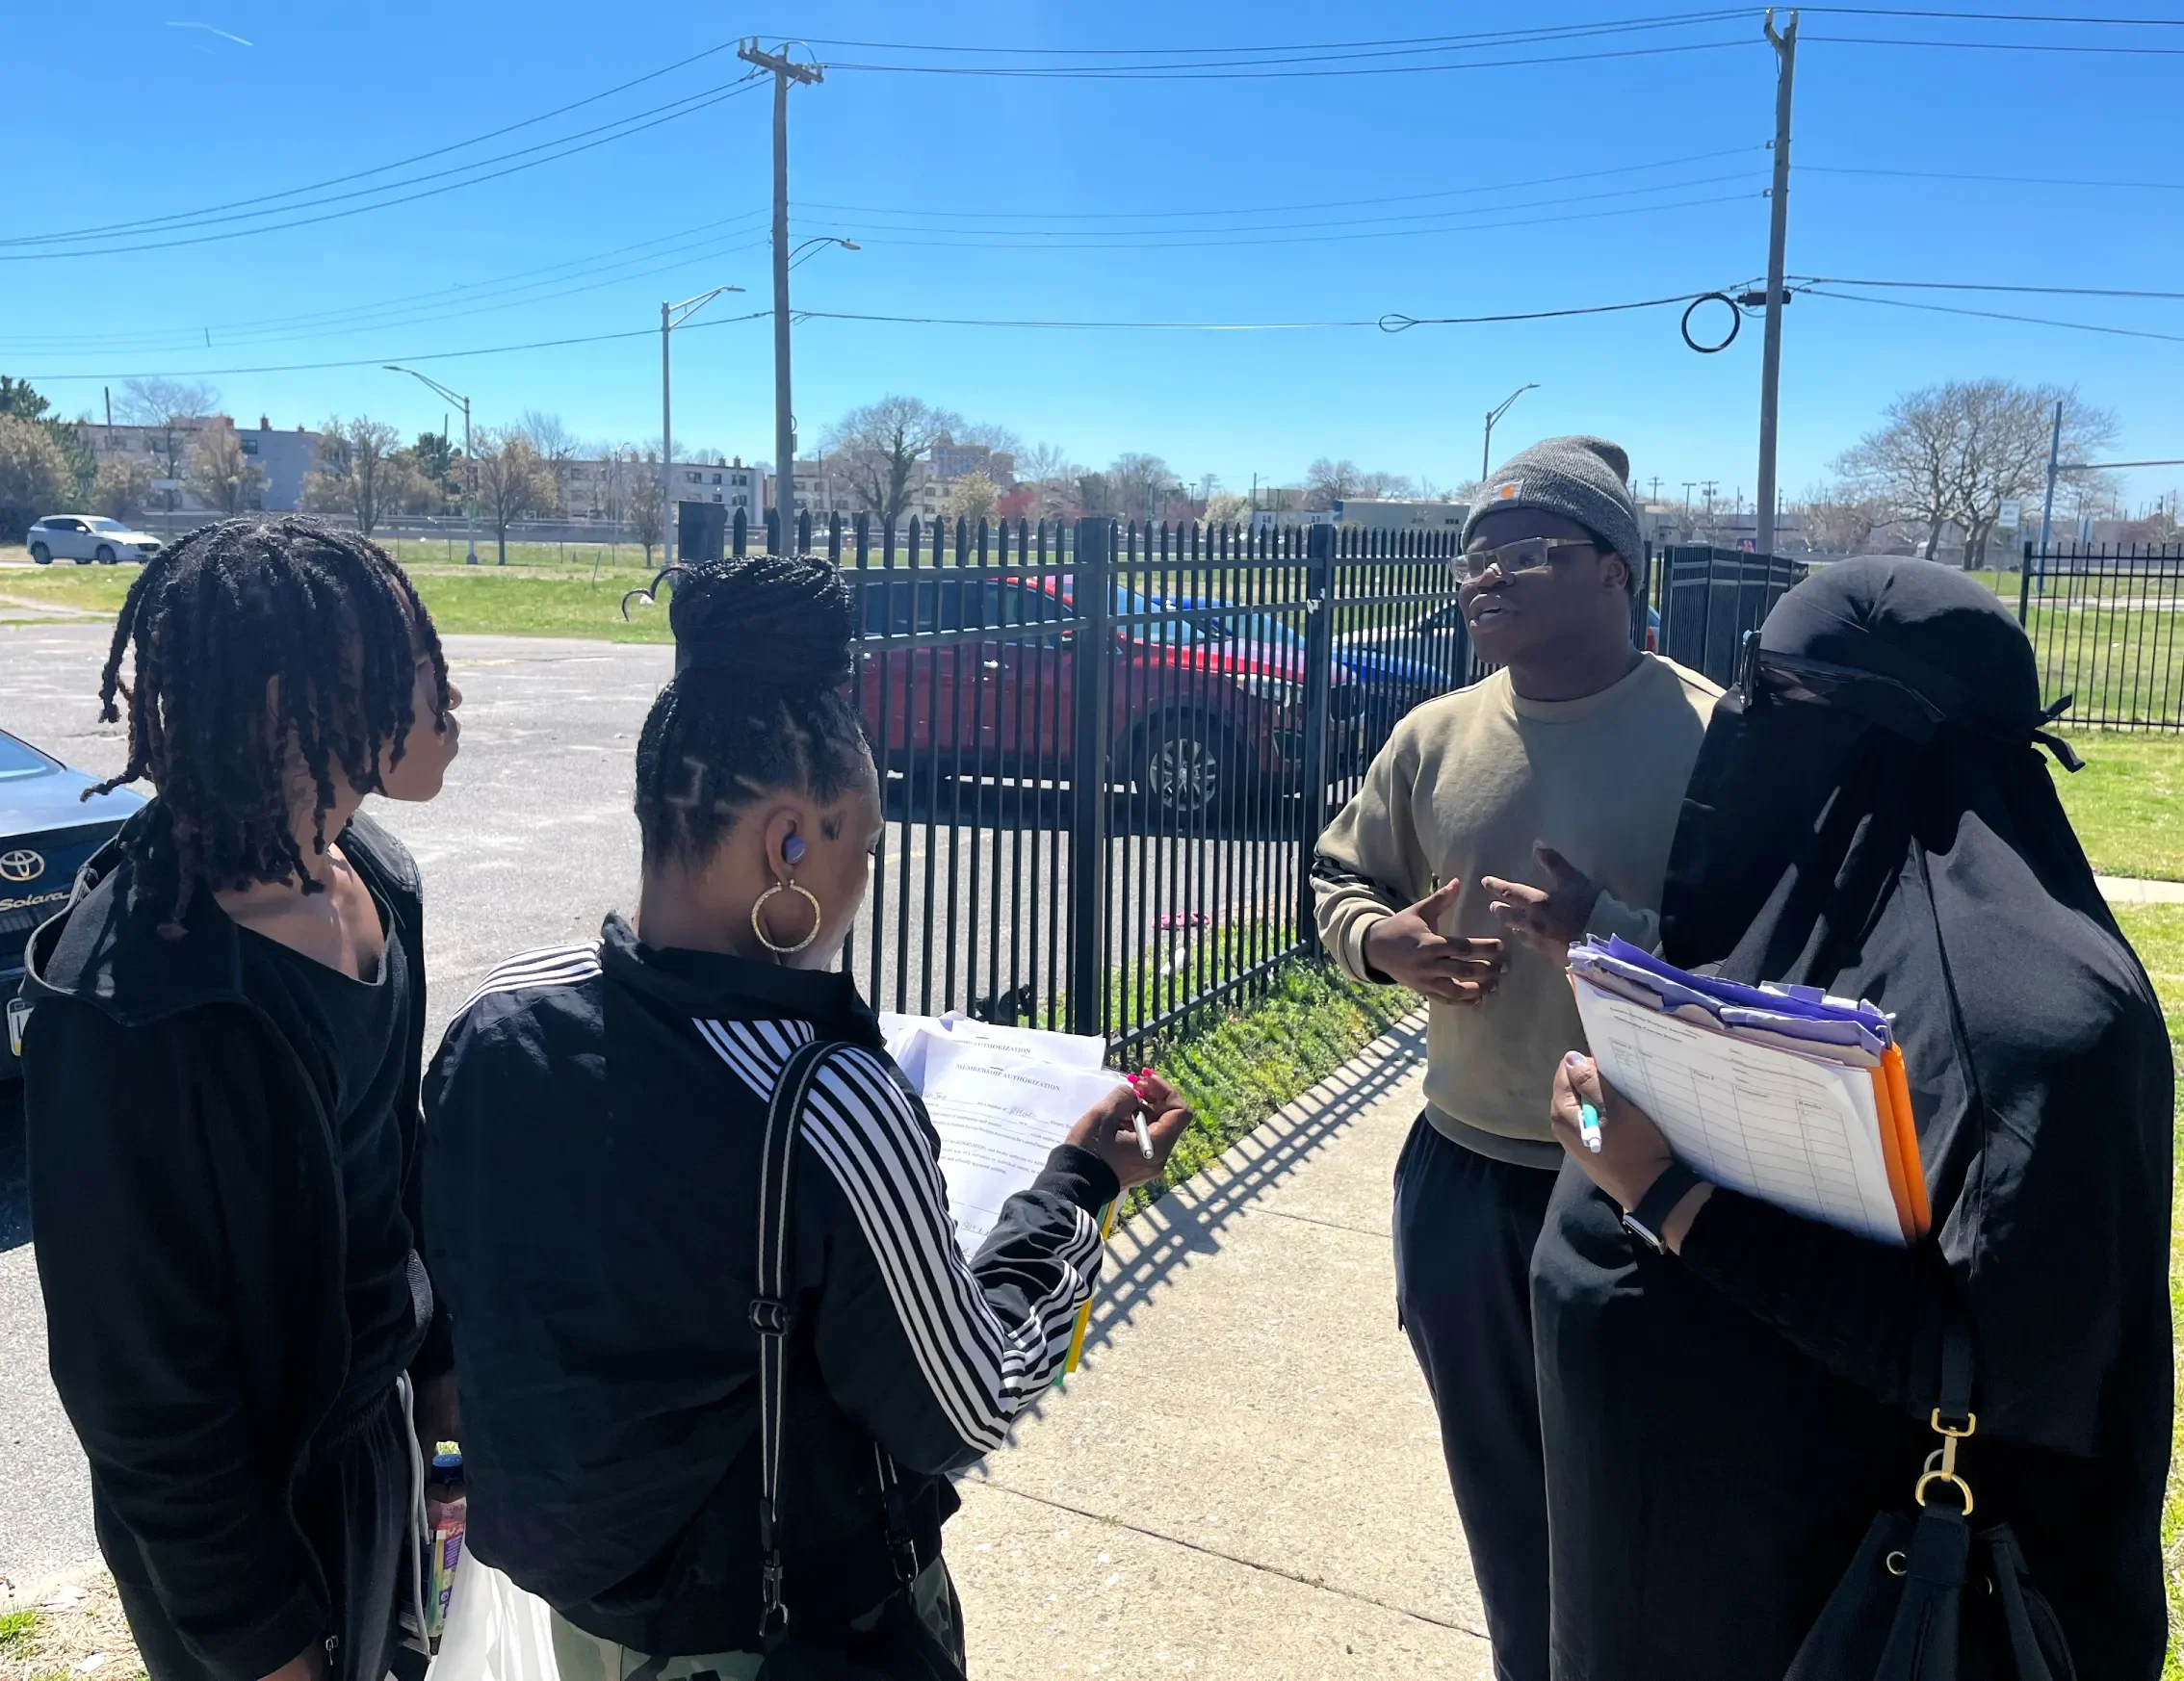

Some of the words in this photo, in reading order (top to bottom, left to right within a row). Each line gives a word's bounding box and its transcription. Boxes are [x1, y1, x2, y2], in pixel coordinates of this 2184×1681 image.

[0, 892, 70, 912] Solara
[955, 1063, 1002, 1076] MEMBERSHIP
[1002, 1073, 1061, 1091] AUTHORIZATION
